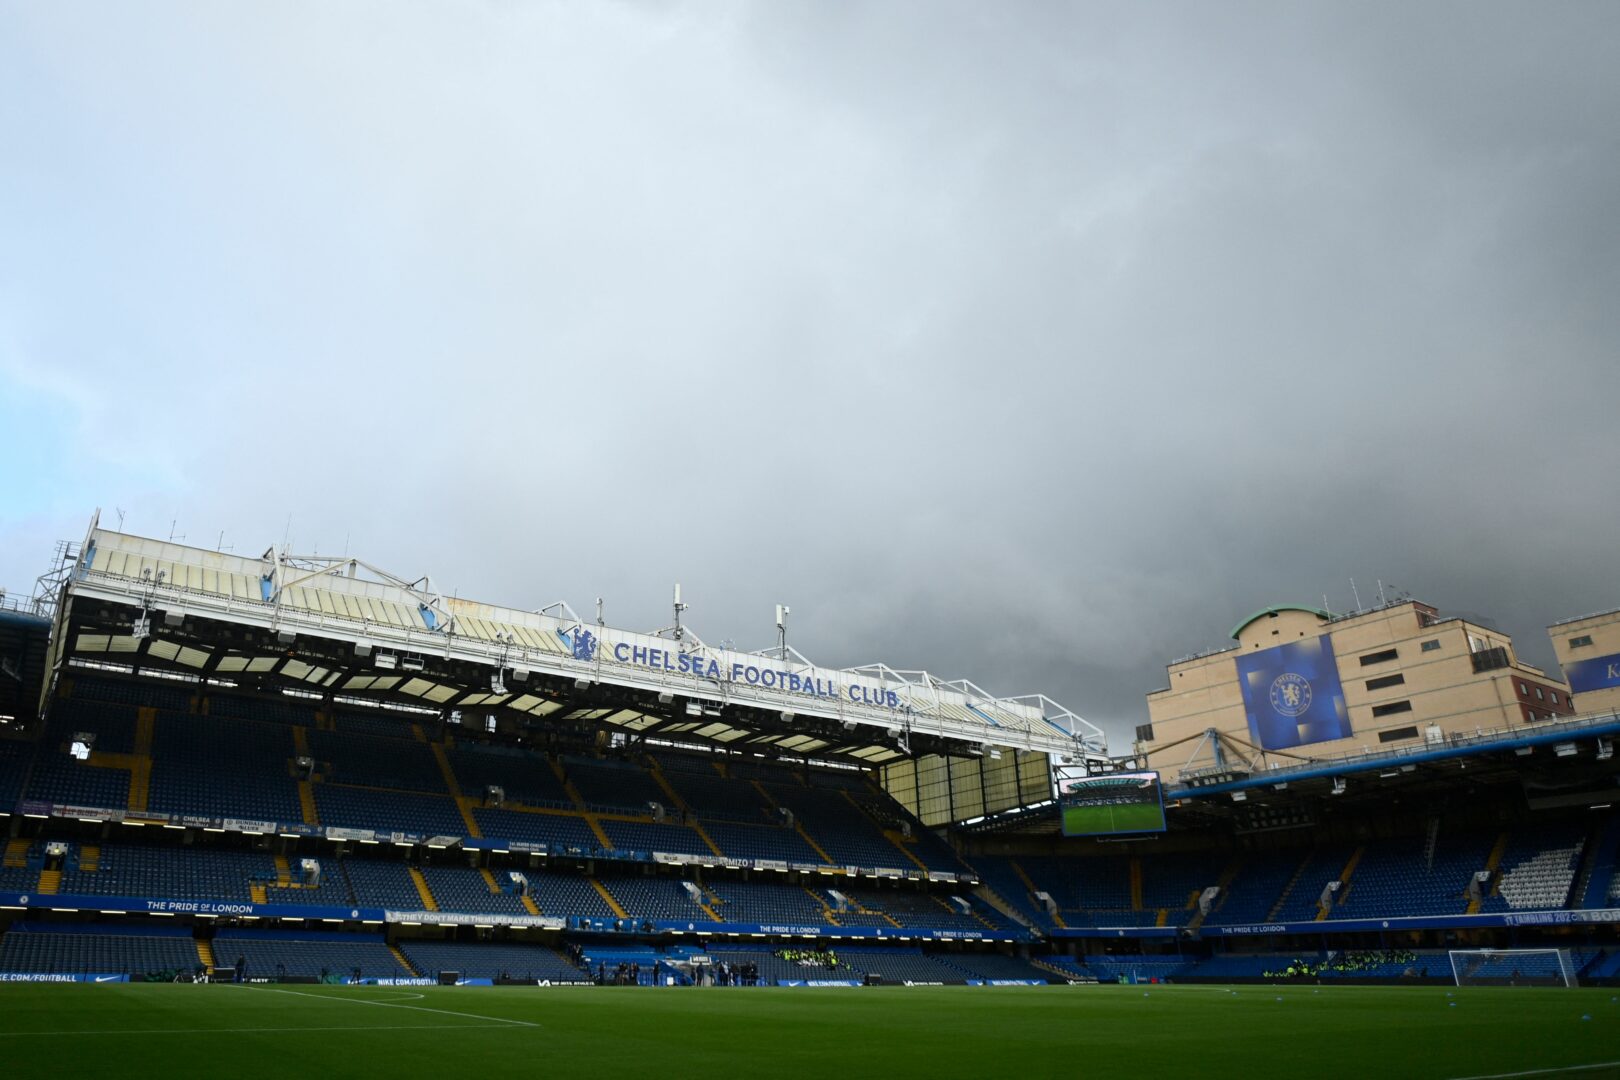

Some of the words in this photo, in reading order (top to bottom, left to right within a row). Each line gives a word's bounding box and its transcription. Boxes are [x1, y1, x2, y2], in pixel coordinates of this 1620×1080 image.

[614, 642, 721, 678] CHELSEA
[732, 663, 839, 697] FOOTBALL
[849, 684, 898, 707] CLUB
[183, 815, 211, 823] CHELSEA
[728, 857, 749, 868] MIZO
[147, 901, 166, 910] THE
[168, 902, 199, 911] PRIDE
[200, 903, 211, 911] OF
[211, 904, 253, 914] LONDON
[760, 925, 771, 933] THE
[772, 925, 789, 933] PRIDE
